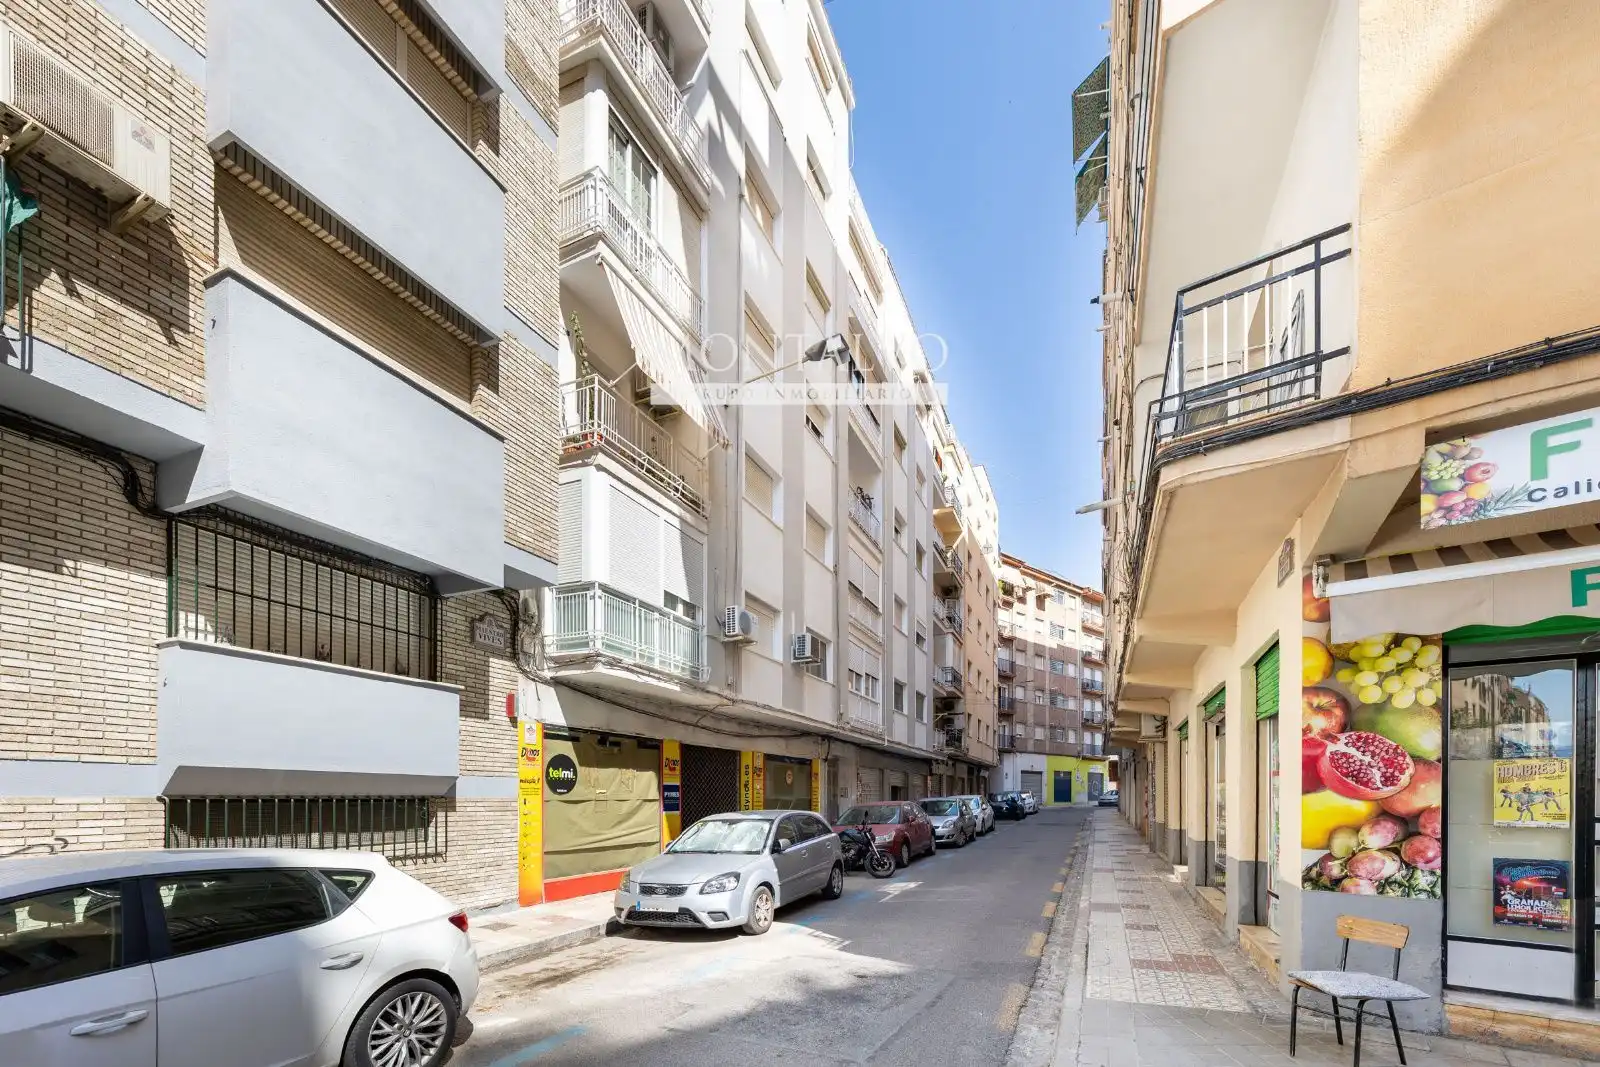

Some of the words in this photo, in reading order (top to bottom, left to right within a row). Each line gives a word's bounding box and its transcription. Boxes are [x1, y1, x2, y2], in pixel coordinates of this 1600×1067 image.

[478, 632, 503, 645] VIVES
[1497, 762, 1557, 778] HOMBRES
[1558, 760, 1567, 773] G
